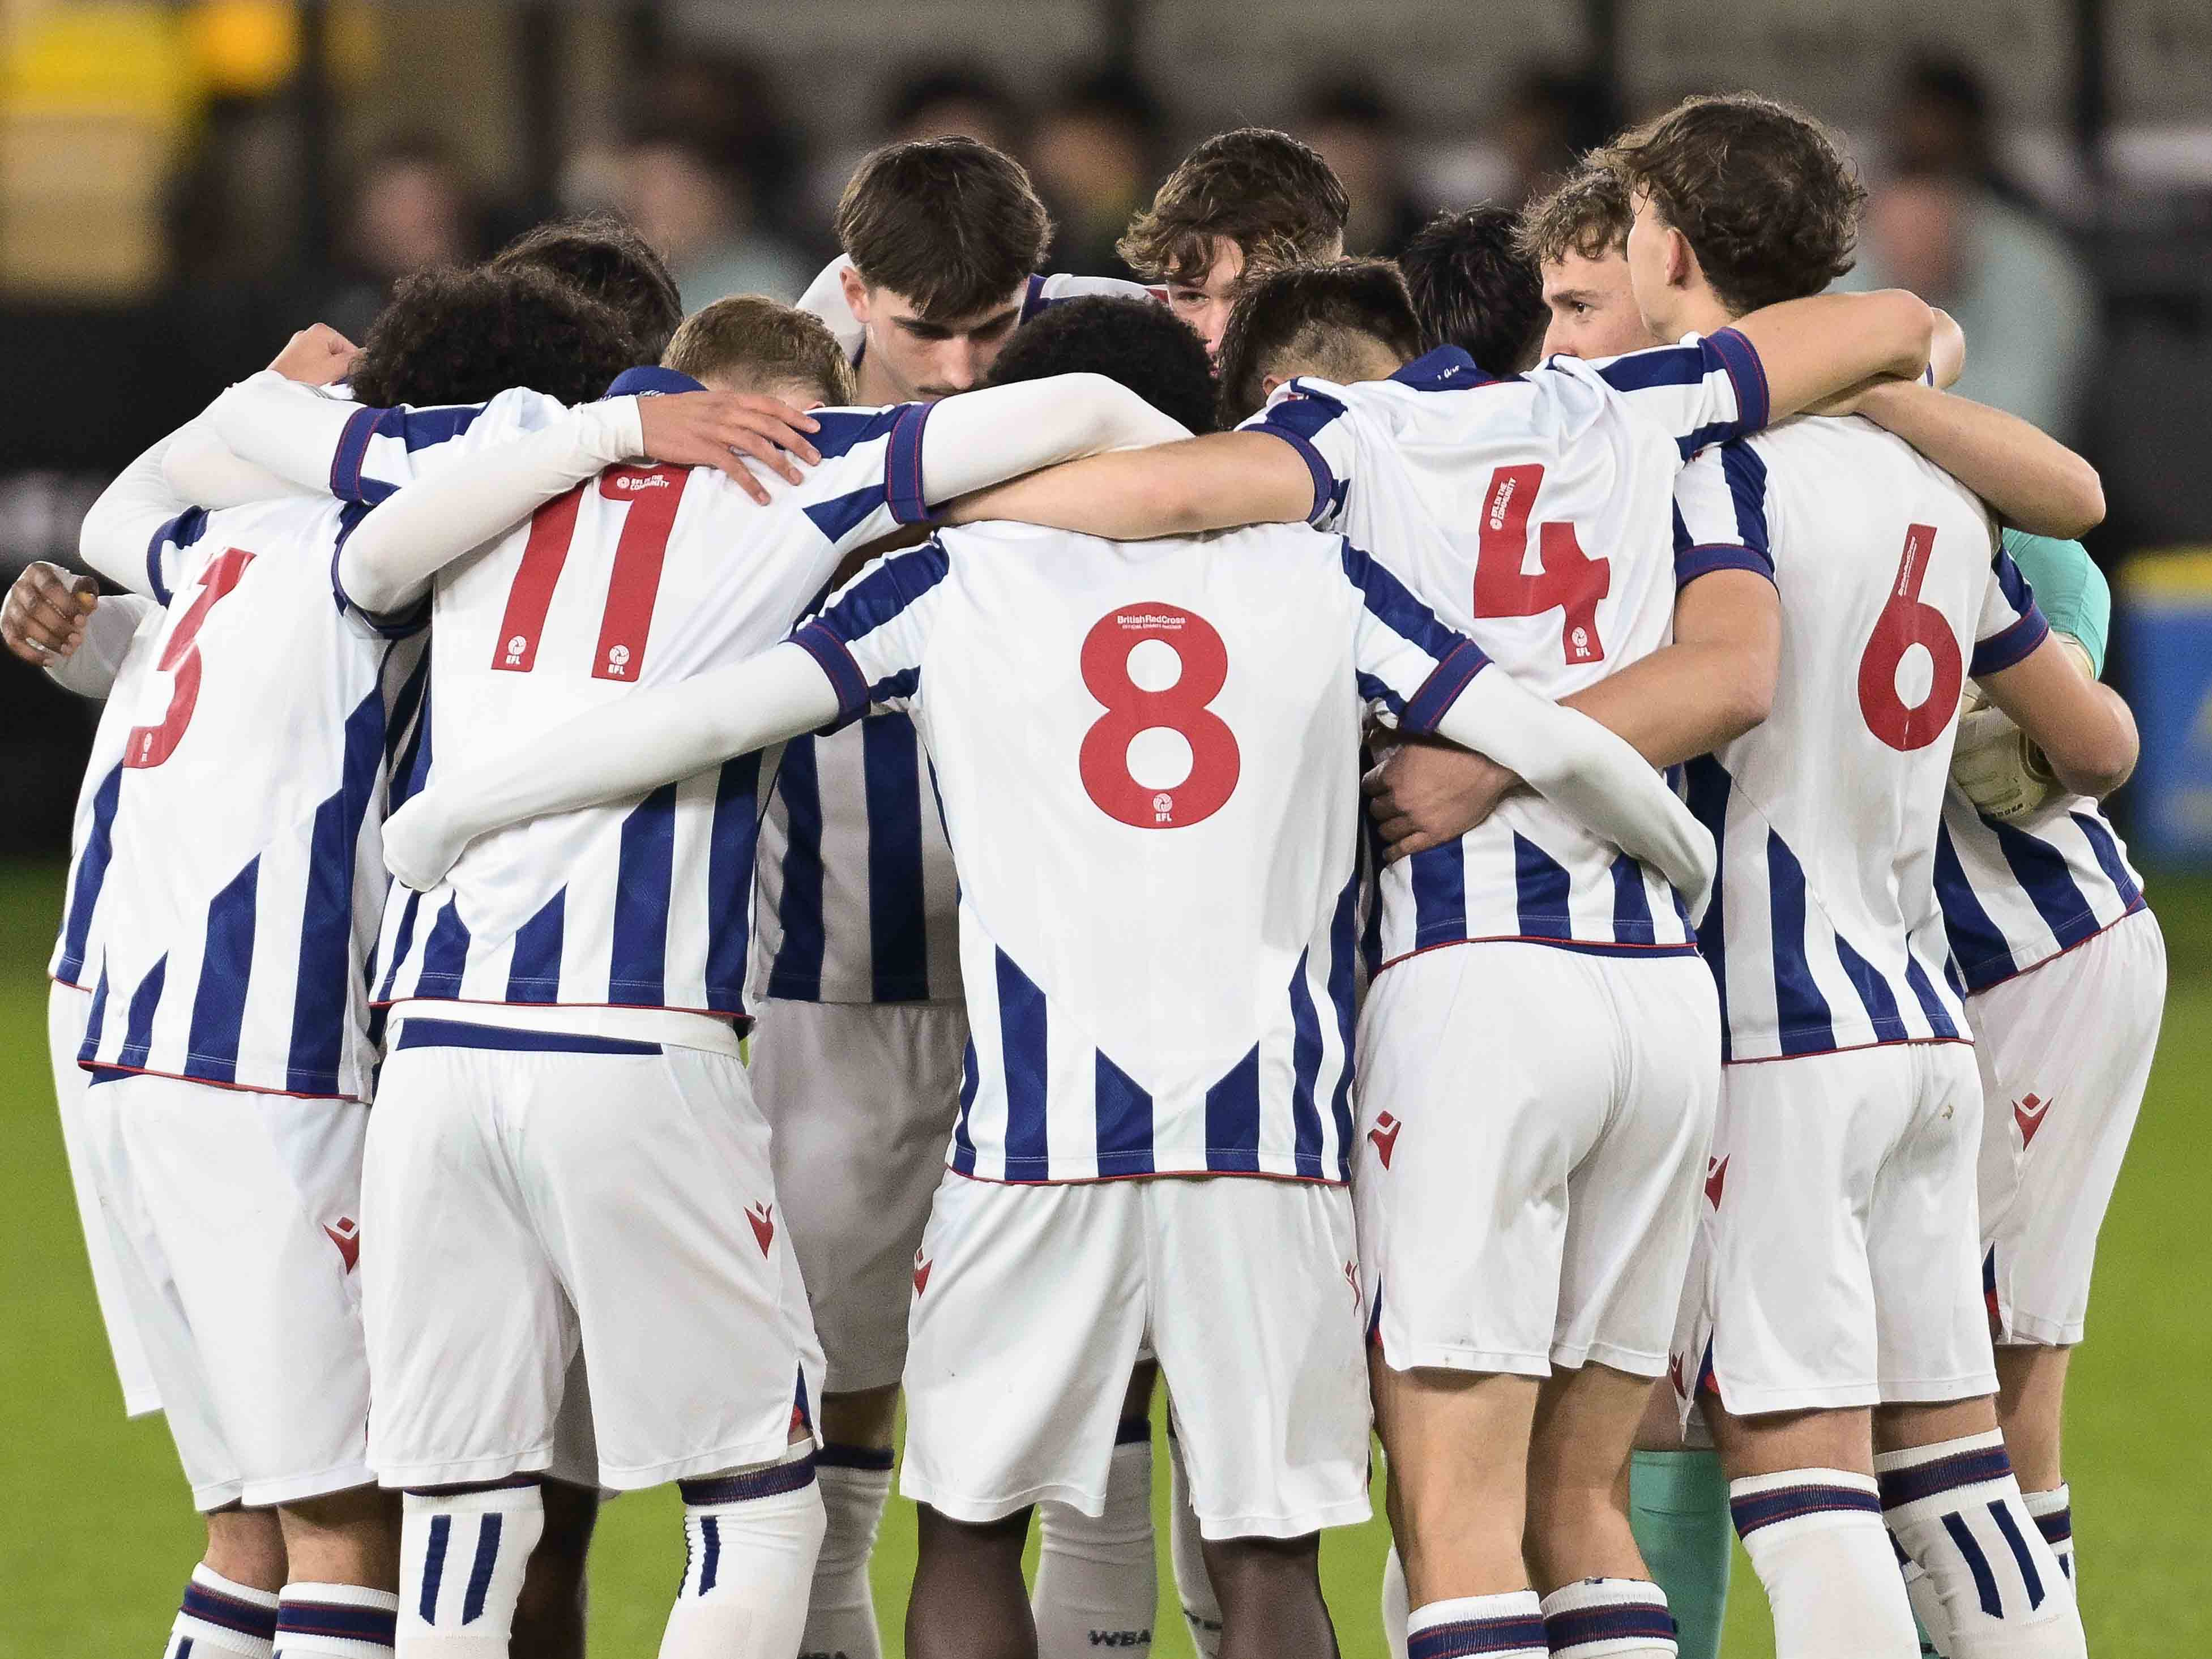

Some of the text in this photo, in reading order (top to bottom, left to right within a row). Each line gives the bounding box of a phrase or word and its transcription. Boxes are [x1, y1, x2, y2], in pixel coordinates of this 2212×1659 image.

[491, 463, 693, 682] 11
[1474, 464, 1610, 665] 4
[505, 654, 520, 665] EFL
[607, 663, 625, 675] EFL
[1576, 647, 1591, 657] EFL
[1858, 523, 1963, 752] 6
[1079, 601, 1240, 829] 8
[1155, 813, 1172, 822] EFL
